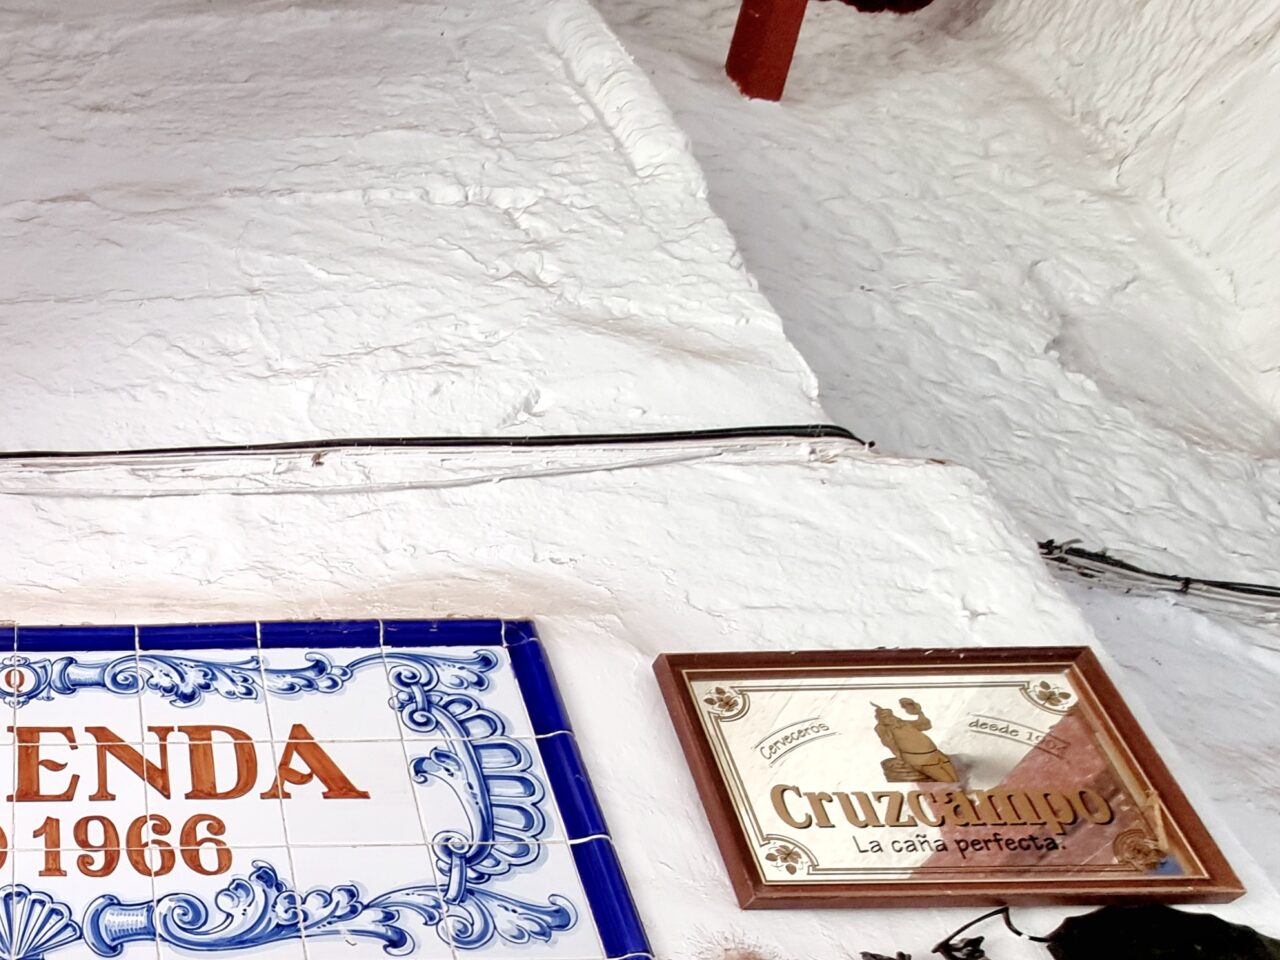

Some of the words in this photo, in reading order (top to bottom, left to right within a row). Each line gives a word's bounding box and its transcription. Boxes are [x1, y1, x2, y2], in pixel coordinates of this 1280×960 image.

[760, 721, 830, 760] Cerveceros
[969, 718, 1020, 737] desde
[770, 783, 1115, 836] Cruzcampo
[38, 811, 234, 878] 1966
[852, 835, 883, 854] La
[891, 833, 949, 853] caña
[955, 832, 1068, 859] perfecta.
